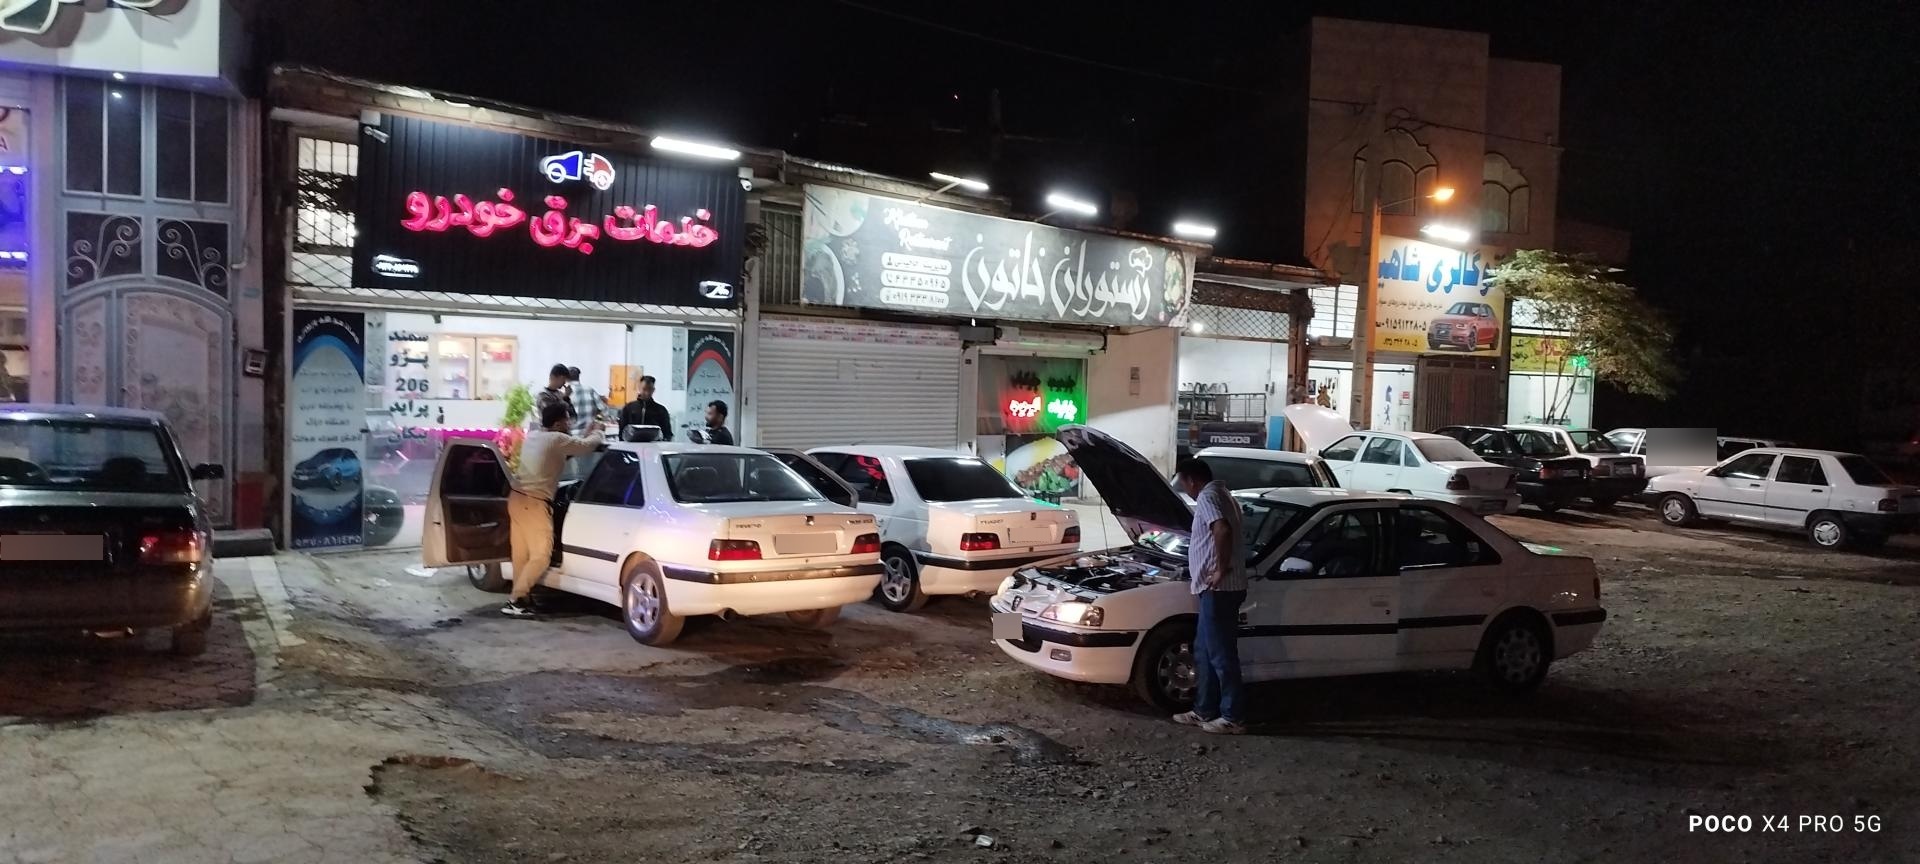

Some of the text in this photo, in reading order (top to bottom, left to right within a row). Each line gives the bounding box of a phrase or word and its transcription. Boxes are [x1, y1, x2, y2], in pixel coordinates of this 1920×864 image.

[401, 188, 718, 255] خدمات برق خودرو
[962, 230, 1152, 320] رستوران خاتون
[1378, 246, 1420, 289] شاهی
[389, 330, 428, 342] سمند
[389, 349, 429, 367] پژو
[396, 378, 429, 393] 206
[389, 400, 429, 418] پراید
[388, 427, 428, 443] پیکان
[1209, 434, 1250, 444] mazda
